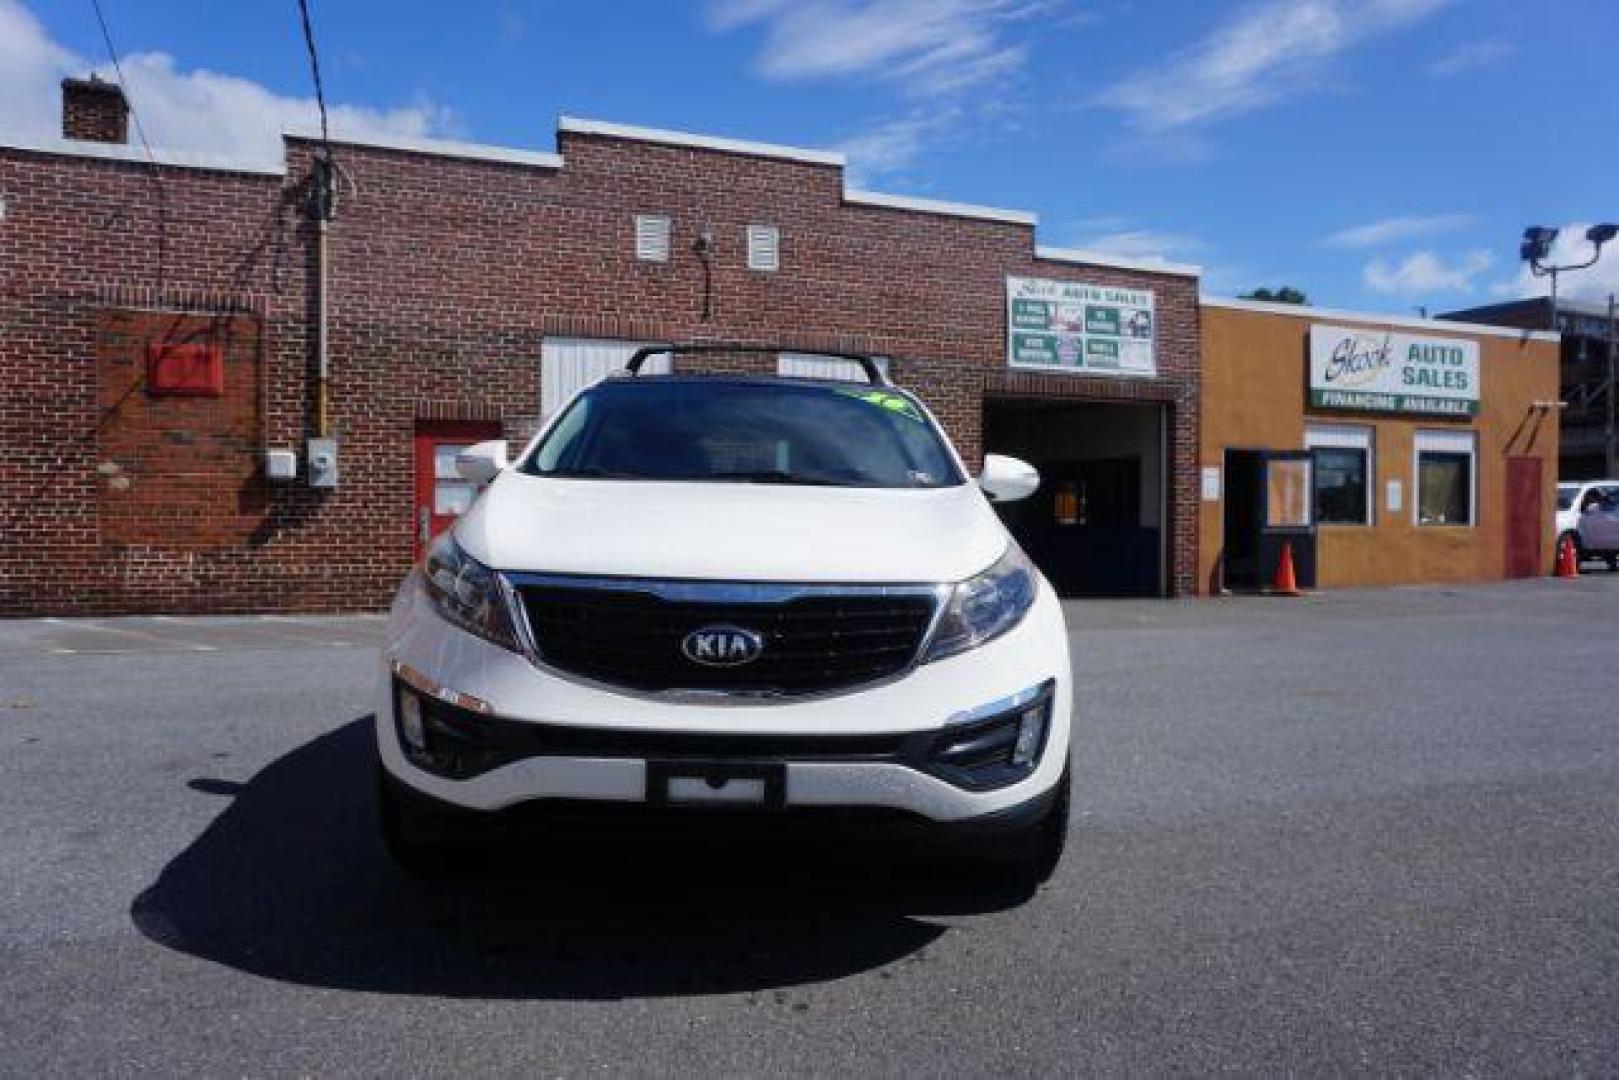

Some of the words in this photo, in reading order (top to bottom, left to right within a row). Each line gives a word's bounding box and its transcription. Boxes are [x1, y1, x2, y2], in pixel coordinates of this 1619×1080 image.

[1408, 343, 1463, 365] AUTO
[1403, 366, 1468, 389] SALES
[696, 634, 746, 657] KIA
